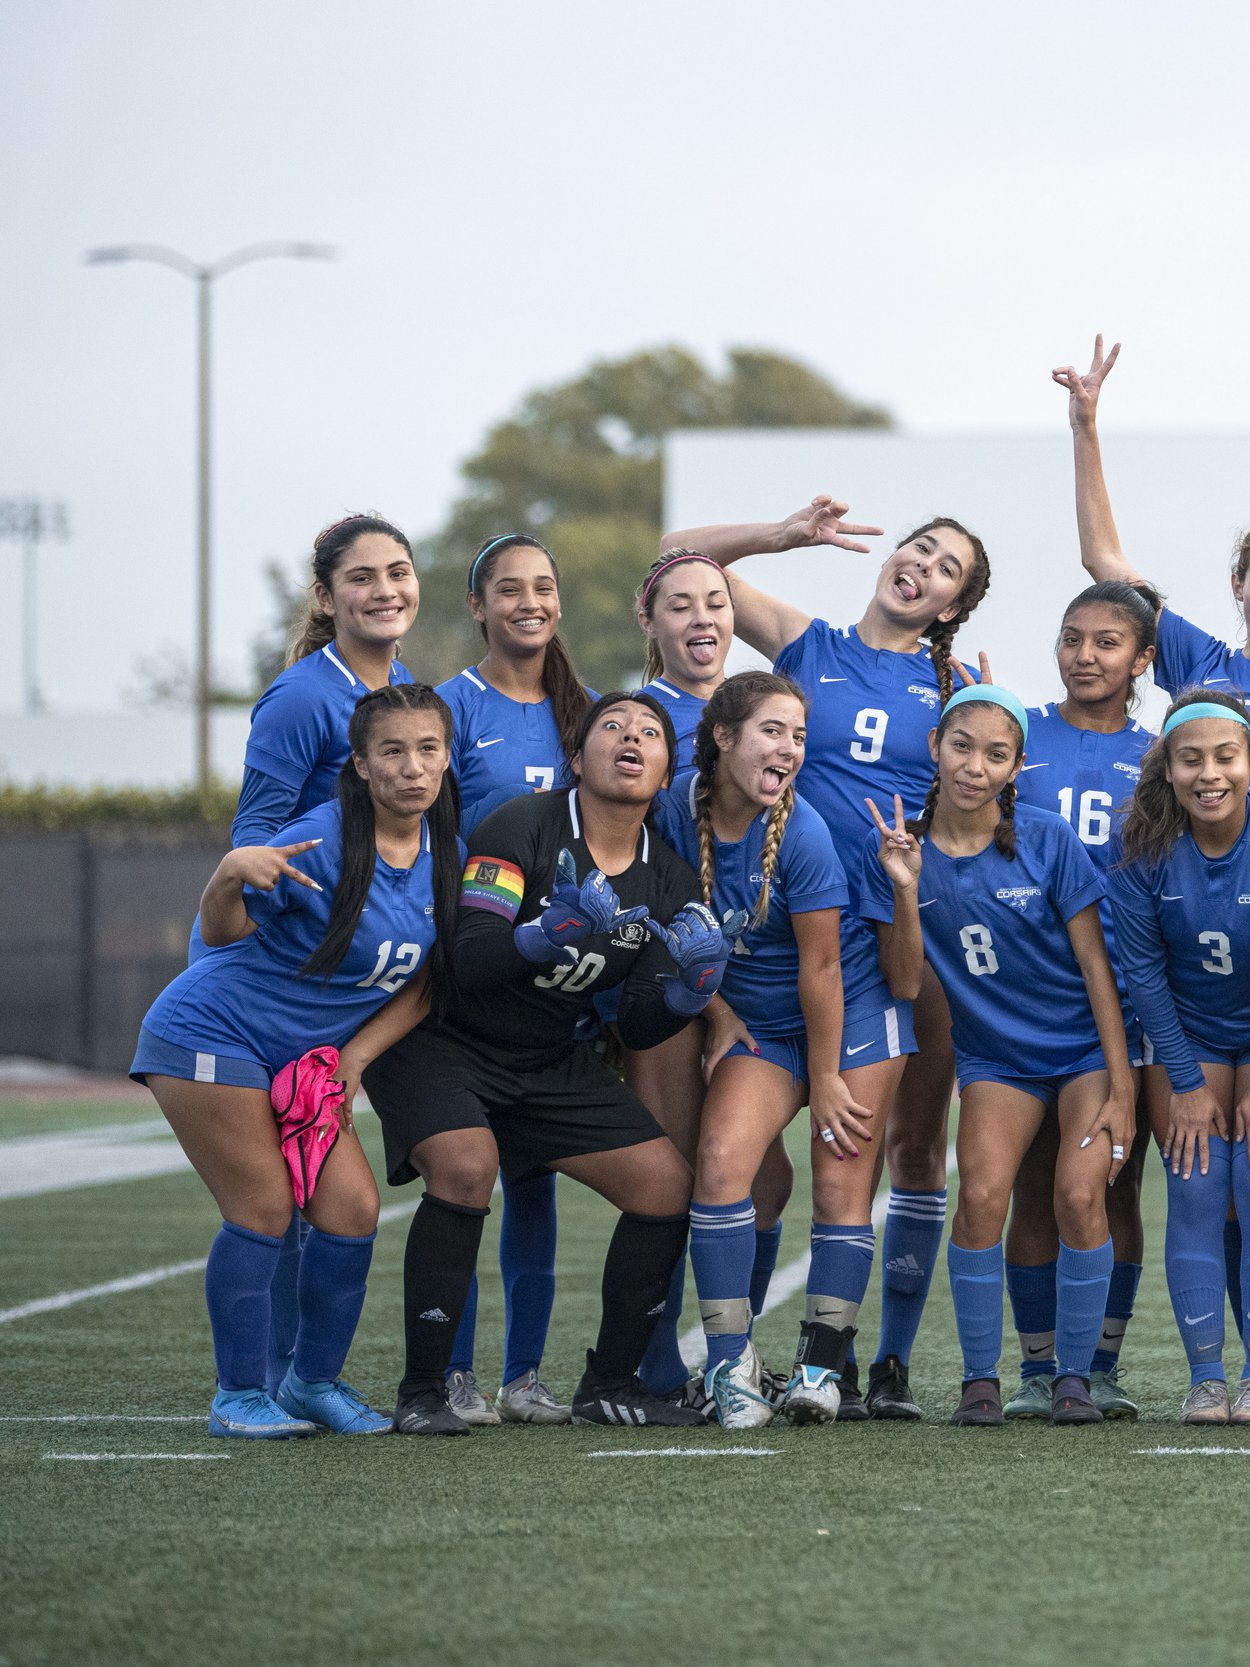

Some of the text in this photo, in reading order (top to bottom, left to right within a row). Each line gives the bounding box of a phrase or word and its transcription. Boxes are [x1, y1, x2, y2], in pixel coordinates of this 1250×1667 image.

[849, 707, 890, 763] 9
[525, 765, 554, 791] 7
[1058, 787, 1113, 846] 16
[996, 888, 1042, 898] CORSAIRS
[356, 940, 422, 993] 12
[533, 945, 606, 993] 30
[959, 924, 999, 976] 8
[1198, 930, 1234, 976] 3
